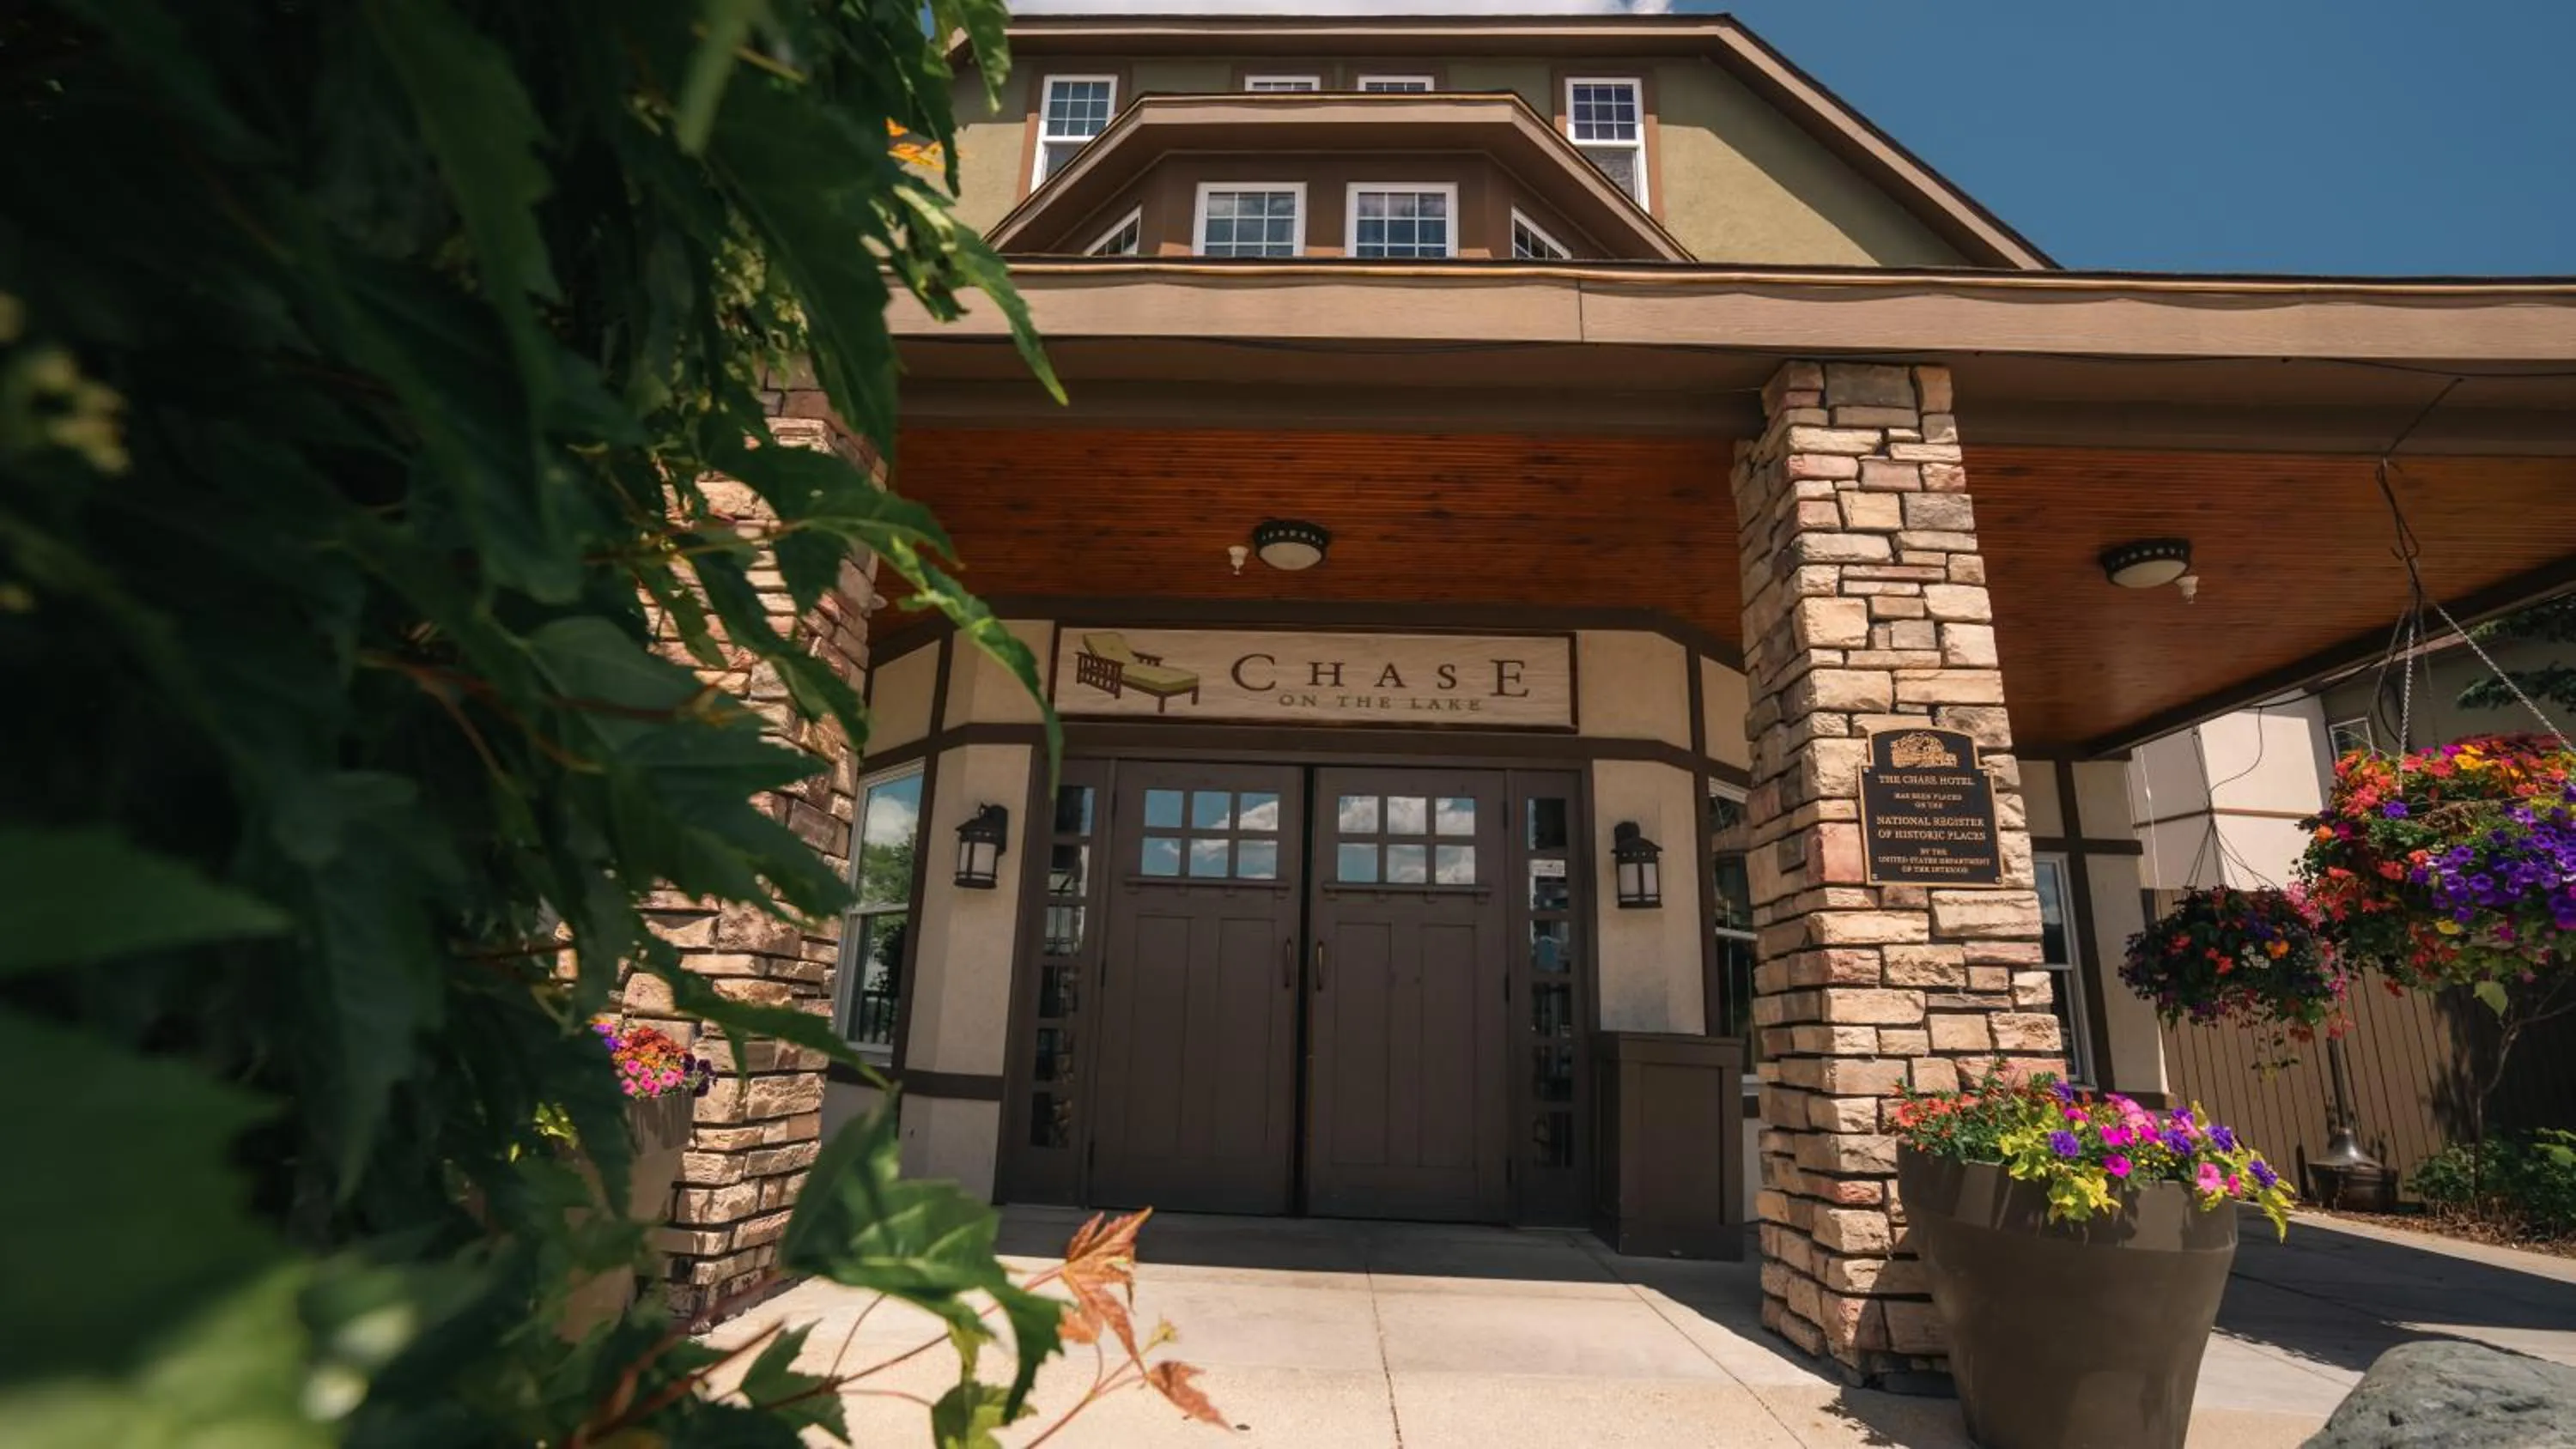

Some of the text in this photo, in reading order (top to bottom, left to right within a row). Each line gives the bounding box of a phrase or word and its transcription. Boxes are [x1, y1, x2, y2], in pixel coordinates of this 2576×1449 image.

[1230, 653, 1530, 698] CHASE
[1279, 694, 1483, 711] ON THE LAKE
[1879, 775, 1975, 785] THE CHASE HOTEL
[1876, 816, 1984, 827] NATIONAL REGISTER
[1878, 829, 1985, 840] OF HISTORIC PLACES
